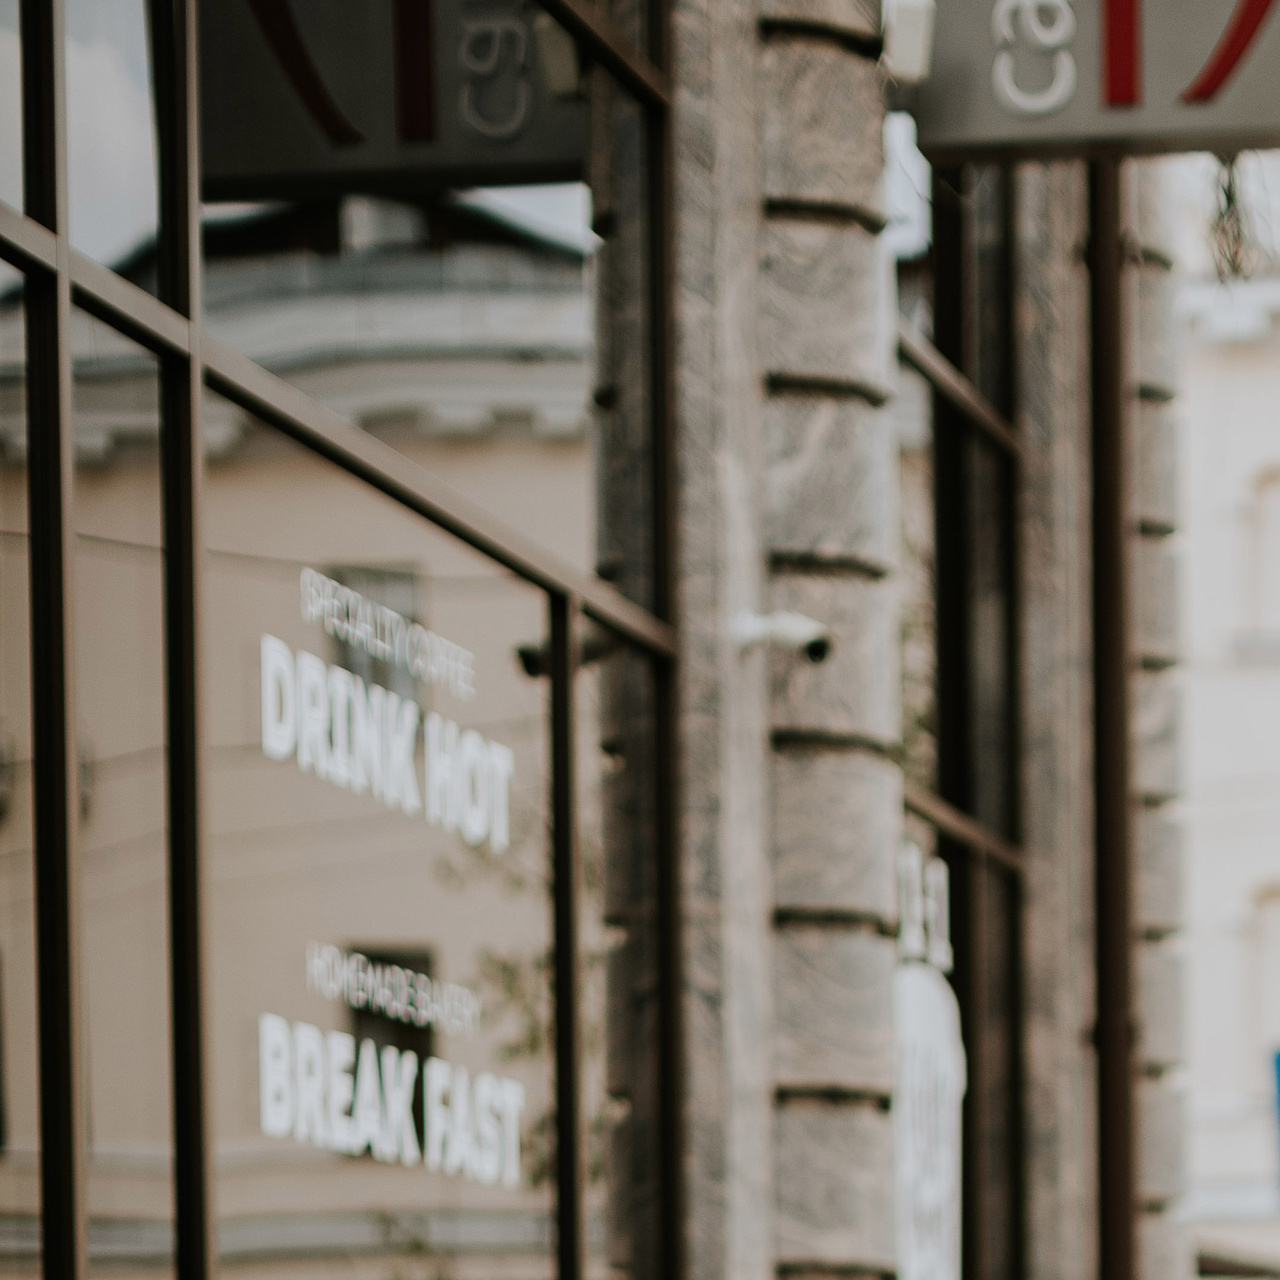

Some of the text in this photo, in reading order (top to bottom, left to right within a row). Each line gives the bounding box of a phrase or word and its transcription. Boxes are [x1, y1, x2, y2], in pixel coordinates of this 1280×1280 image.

[260, 632, 514, 854] DRINK HOT
[259, 1012, 525, 1189] BREAK FAST
